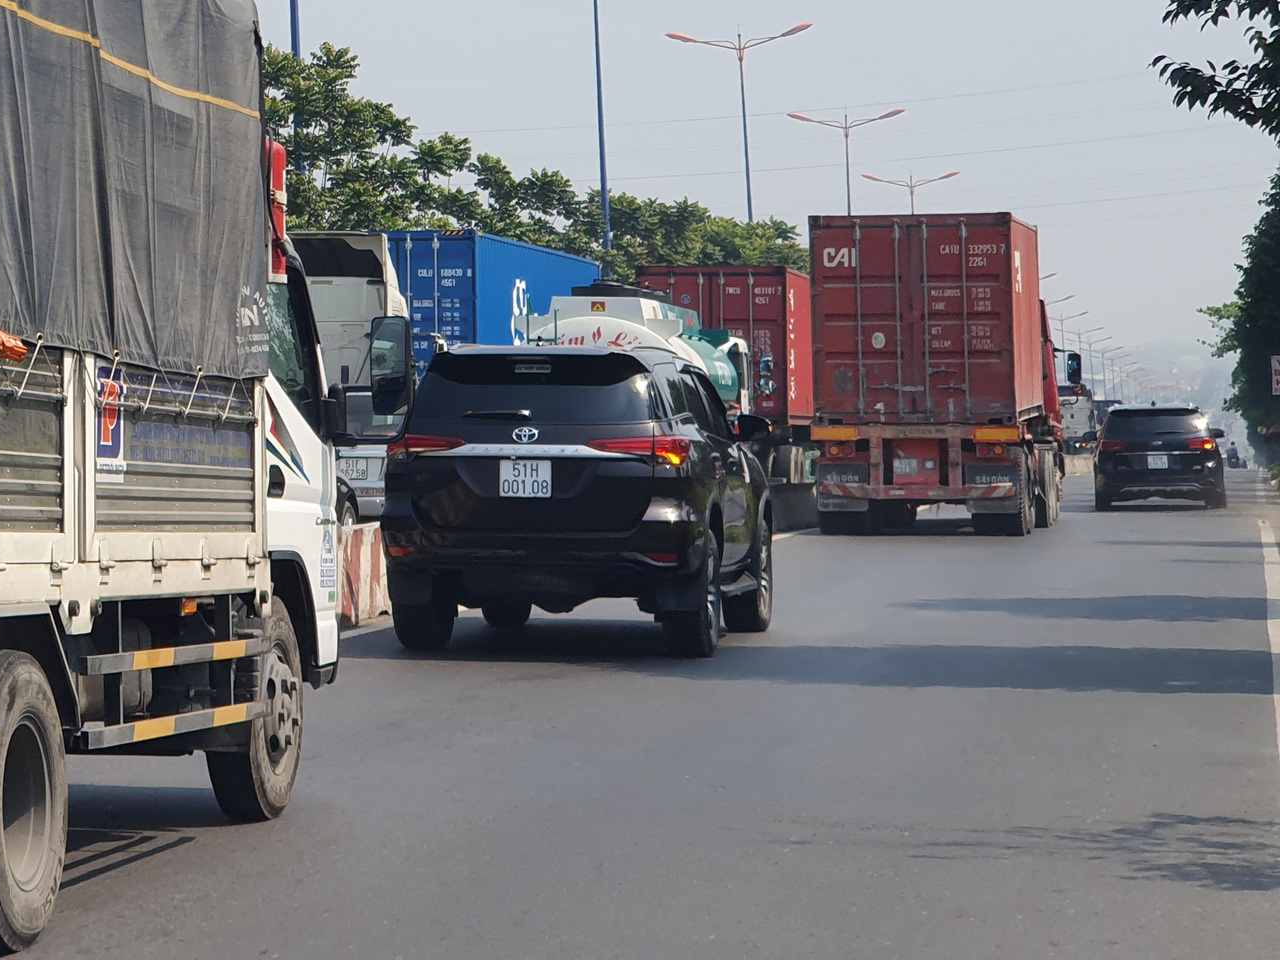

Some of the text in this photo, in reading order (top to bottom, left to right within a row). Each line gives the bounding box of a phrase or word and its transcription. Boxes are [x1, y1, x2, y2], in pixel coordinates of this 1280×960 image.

[940, 244, 1006, 254] CAIU 332953 7
[823, 247, 857, 268] CAI
[968, 257, 987, 267] 22G1
[512, 462, 539, 478] 51H
[502, 479, 549, 495] 001.08
